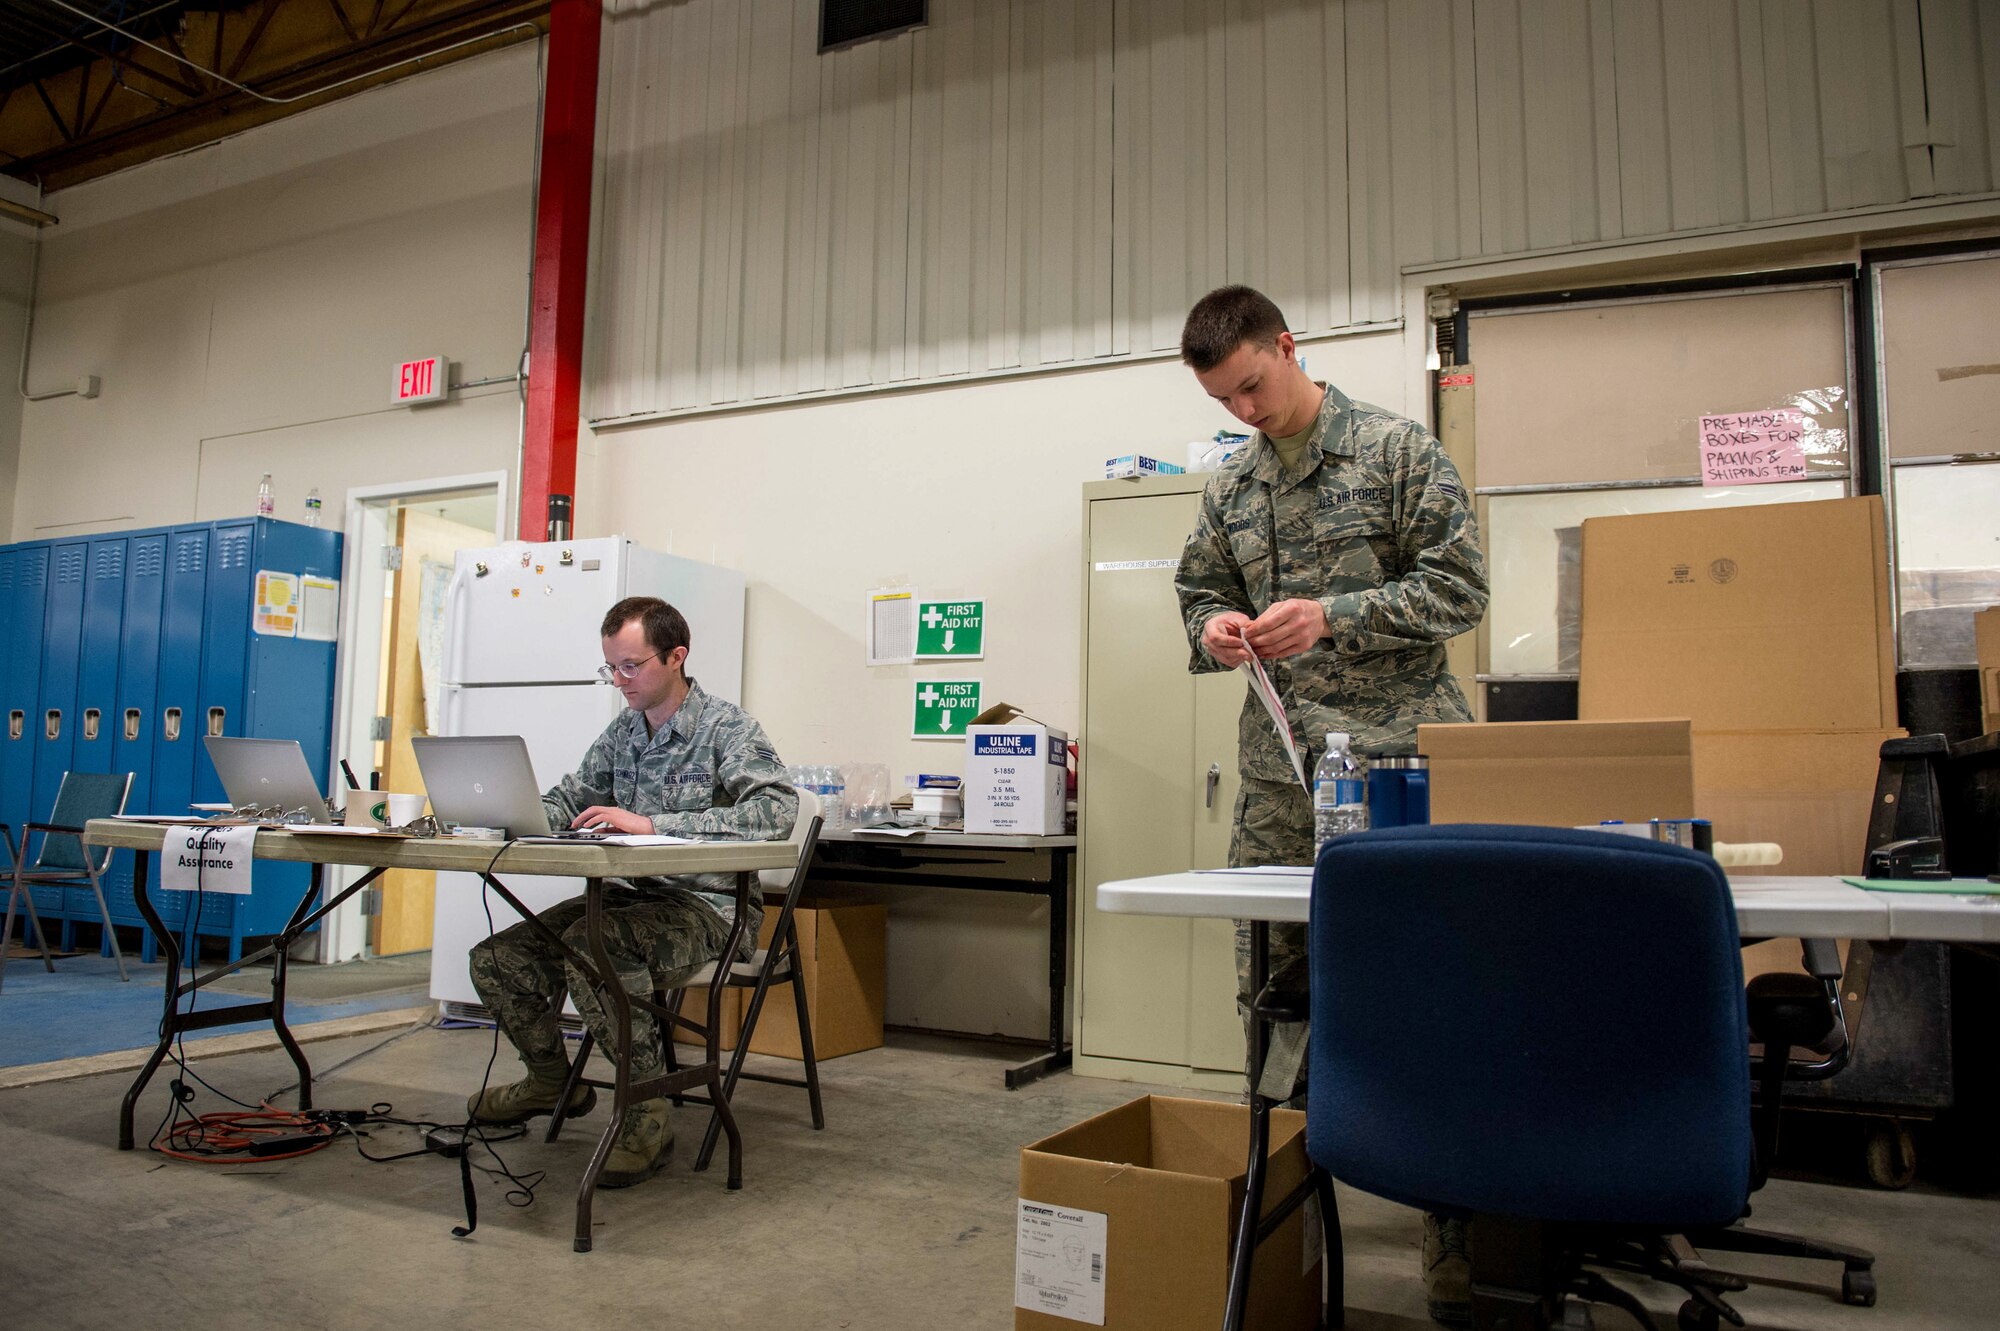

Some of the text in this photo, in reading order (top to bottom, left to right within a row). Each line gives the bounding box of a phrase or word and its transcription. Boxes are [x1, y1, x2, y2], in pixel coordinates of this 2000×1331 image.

[400, 359, 435, 398] EXIT
[1703, 414, 1784, 431] PRE-MADE
[1706, 430, 1800, 447] BOXES FOR
[1139, 455, 1158, 471] BEST
[1767, 450, 1780, 464] &
[1708, 466, 1769, 481] SHIPPING
[1336, 491, 1351, 504] AIR
[1352, 487, 1386, 501] FORCE
[1103, 559, 1180, 569] WAREHOUSE SUPPLIES
[947, 604, 976, 616] FIRST
[941, 617, 981, 629] AID KIT
[943, 684, 973, 695] FIRST
[938, 697, 978, 708] AID KIT
[989, 736, 1021, 747] ULINE
[978, 746, 1015, 754] INDUSTRIAL
[664, 773, 711, 785] U.S. AIR FORCE
[186, 837, 226, 854] Quality
[1057, 1212, 1084, 1223] Coverall
